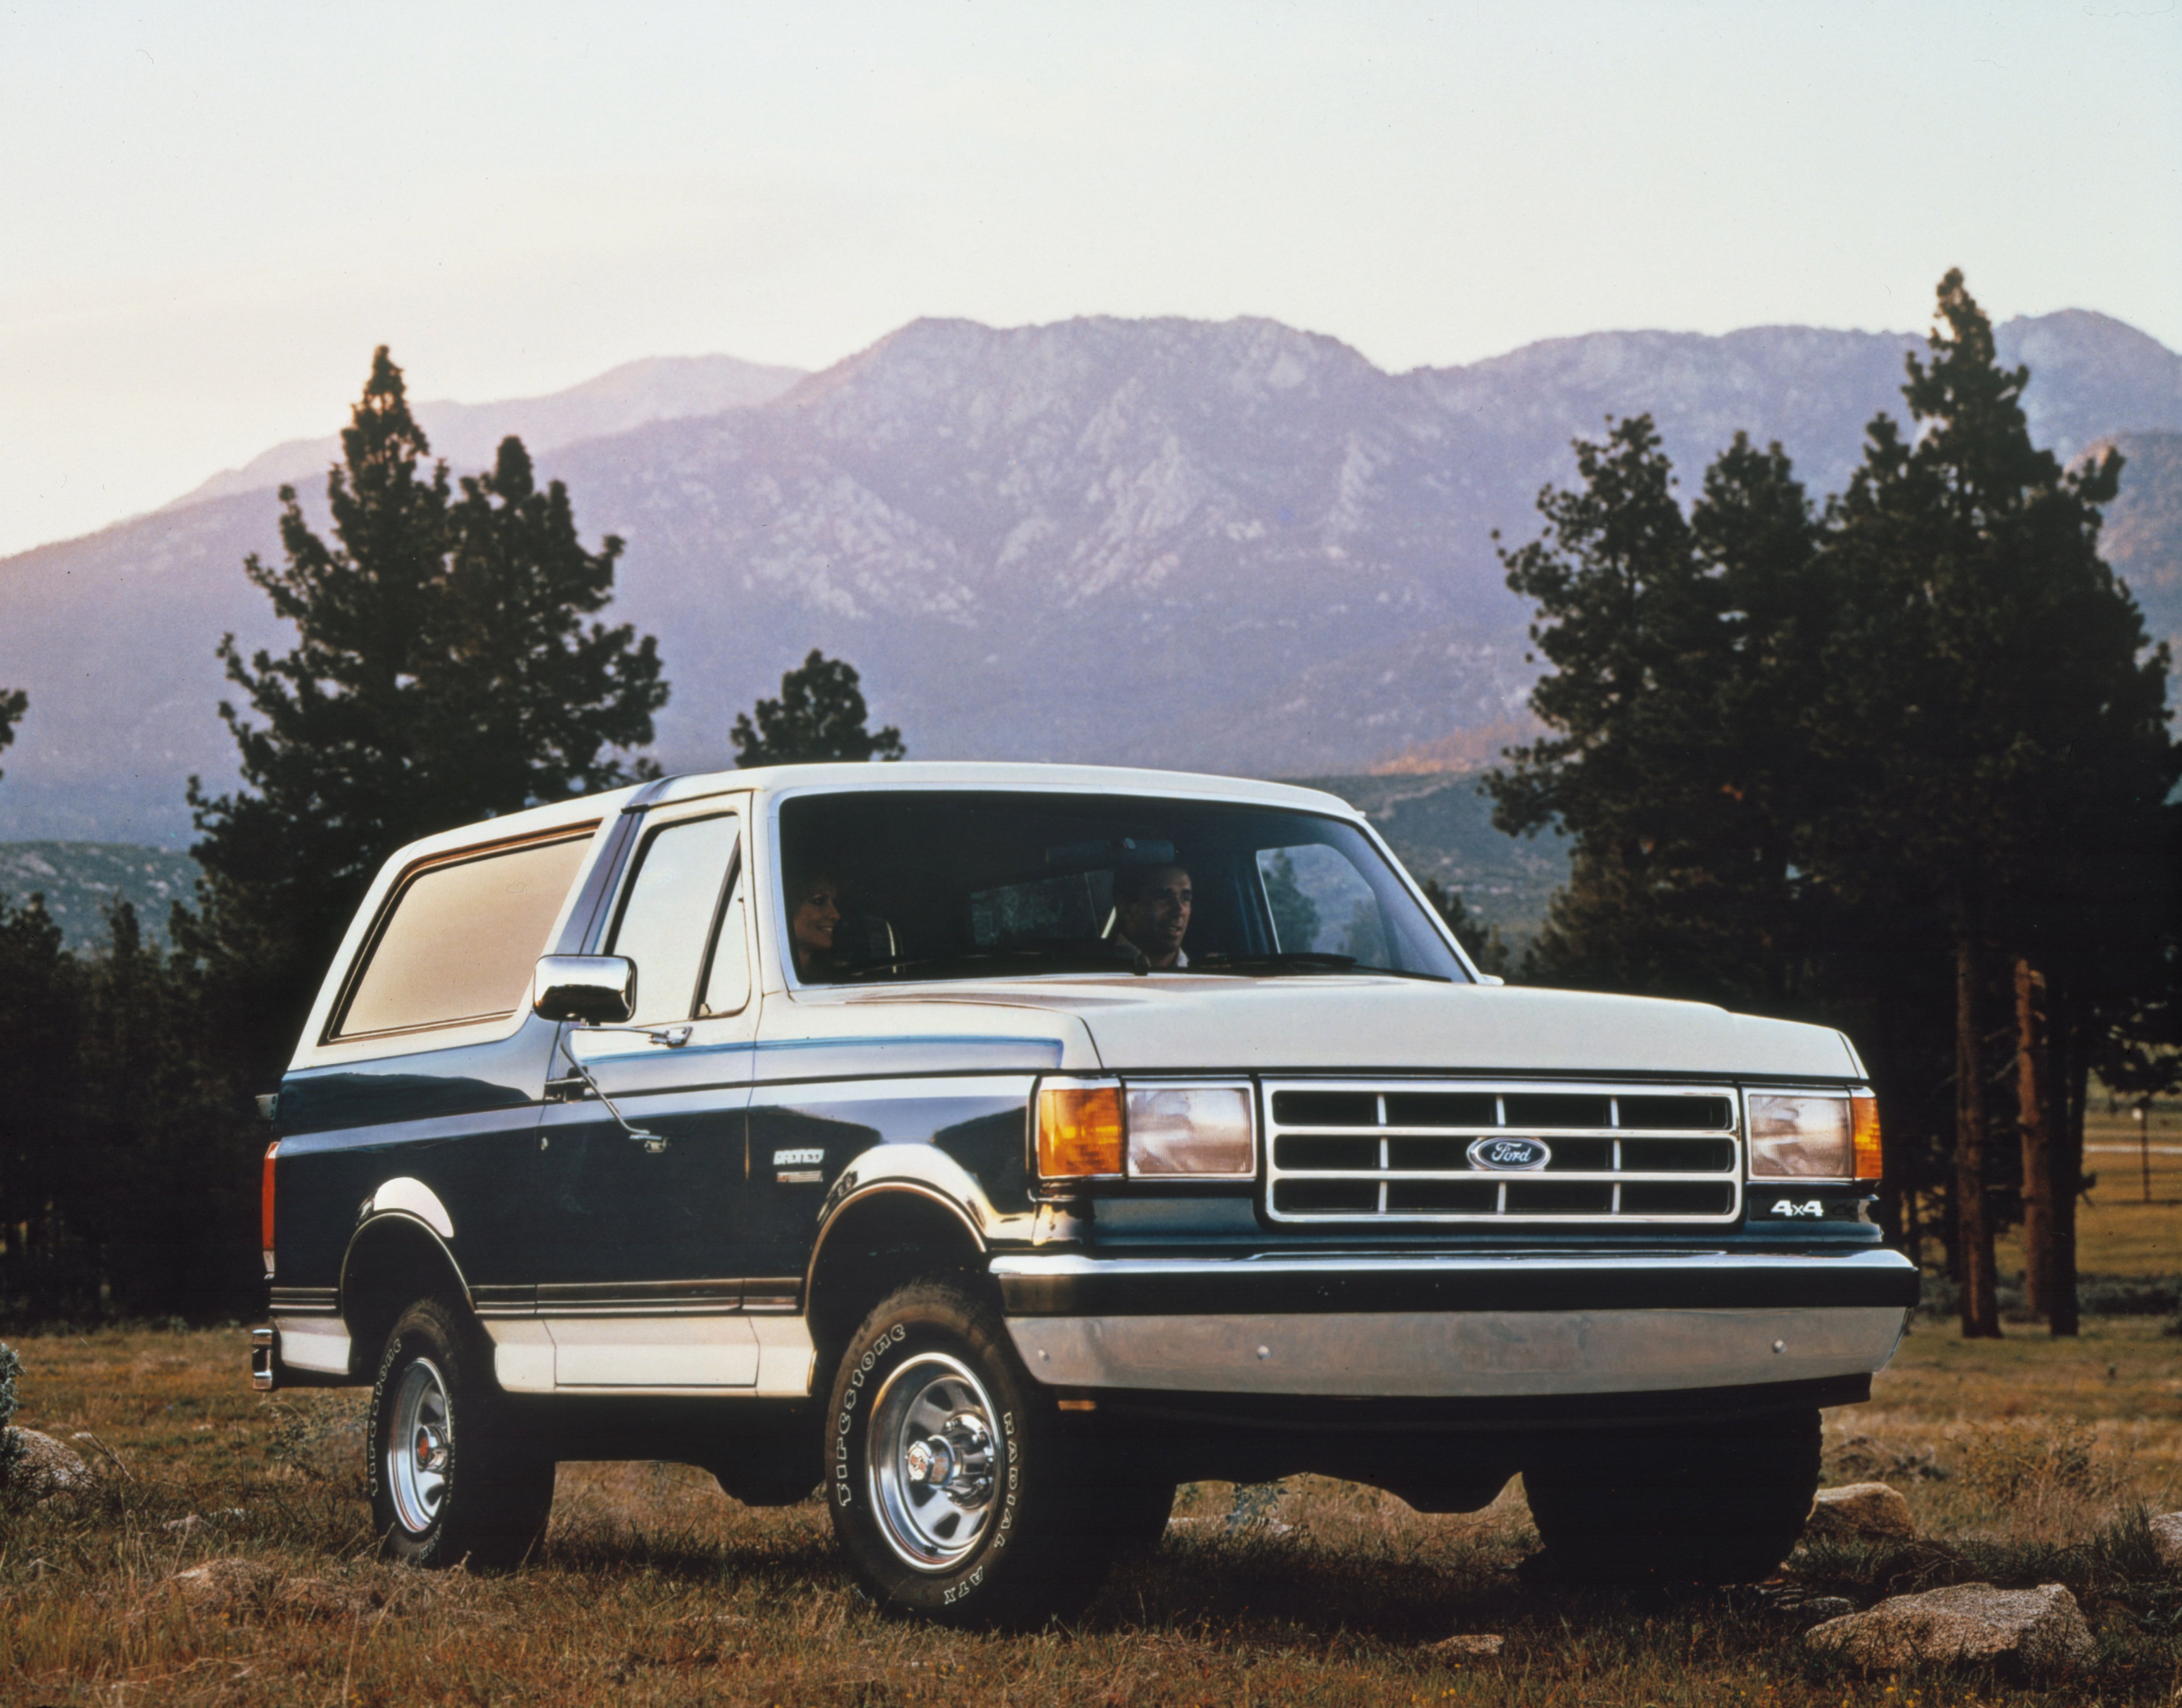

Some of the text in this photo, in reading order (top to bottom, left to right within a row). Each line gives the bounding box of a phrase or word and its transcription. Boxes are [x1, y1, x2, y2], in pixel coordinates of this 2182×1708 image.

[1491, 1142, 1531, 1162] Ford
[1770, 1199, 1824, 1217] 4x4
[944, 1411, 1019, 1605] RADIAL ATX
